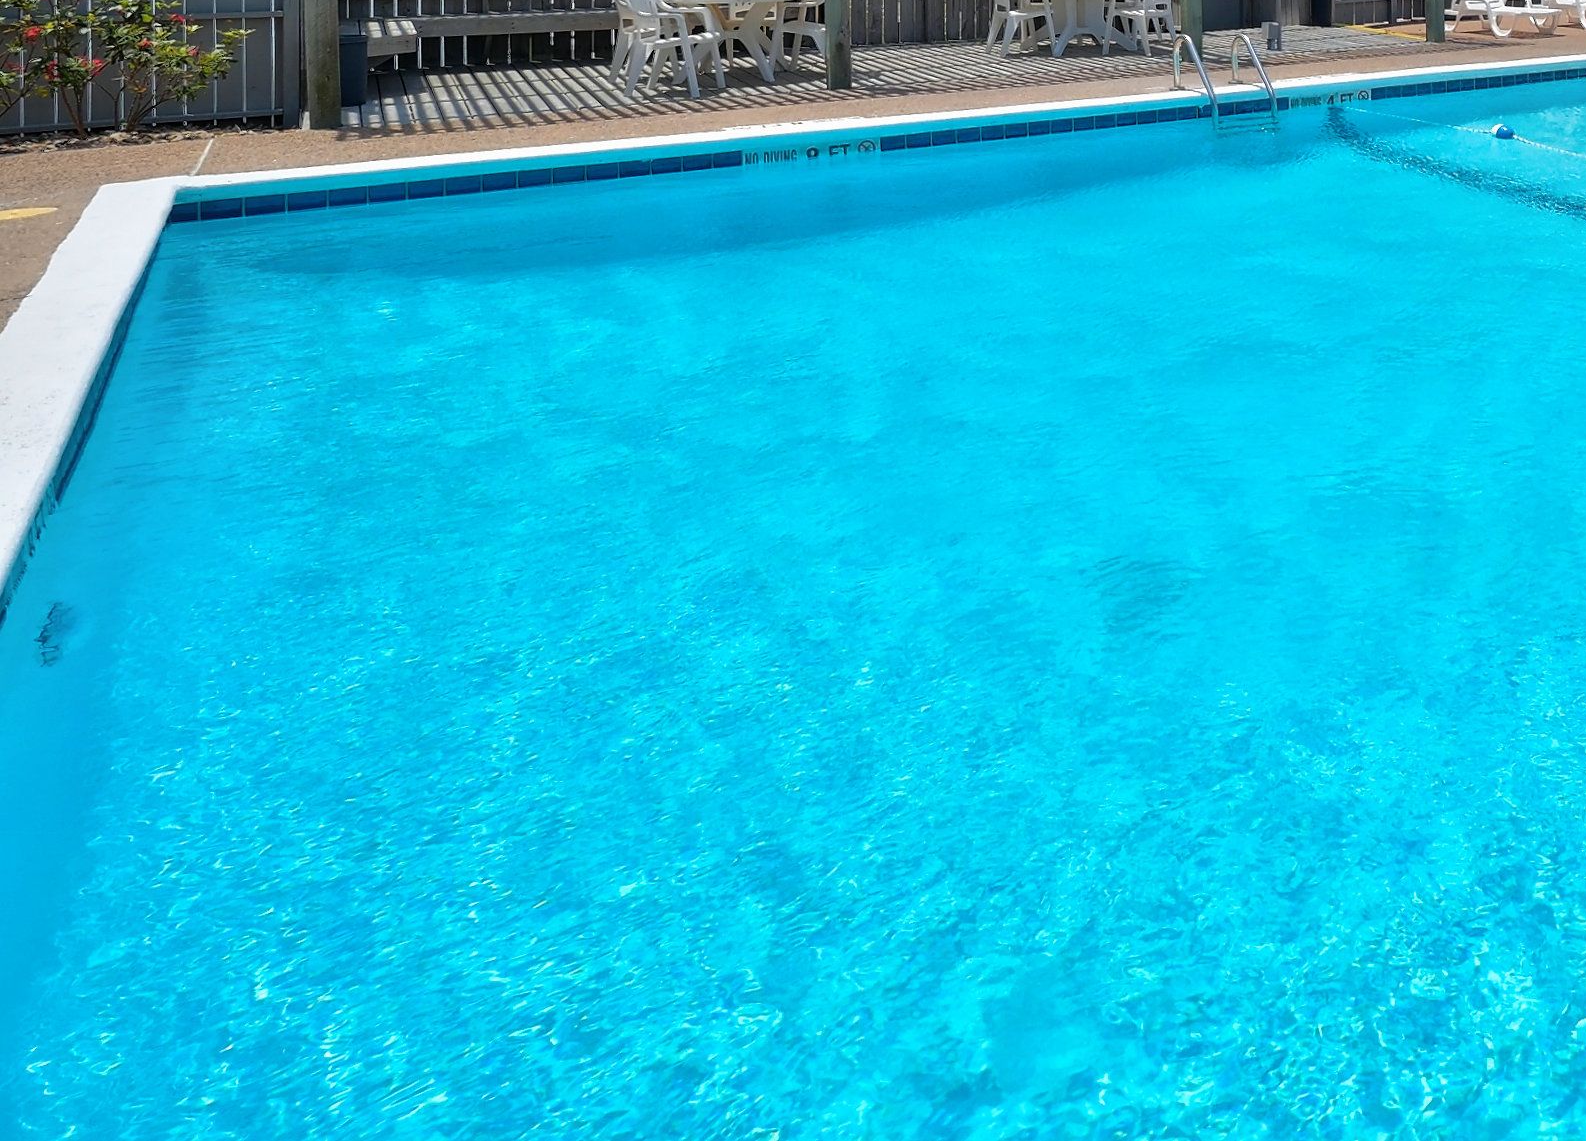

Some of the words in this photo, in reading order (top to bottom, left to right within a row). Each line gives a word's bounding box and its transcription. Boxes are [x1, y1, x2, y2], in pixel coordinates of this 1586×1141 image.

[1340, 92, 1354, 104] FT
[745, 152, 759, 165] NO
[763, 149, 798, 163] DIVING
[829, 144, 850, 157] FT
